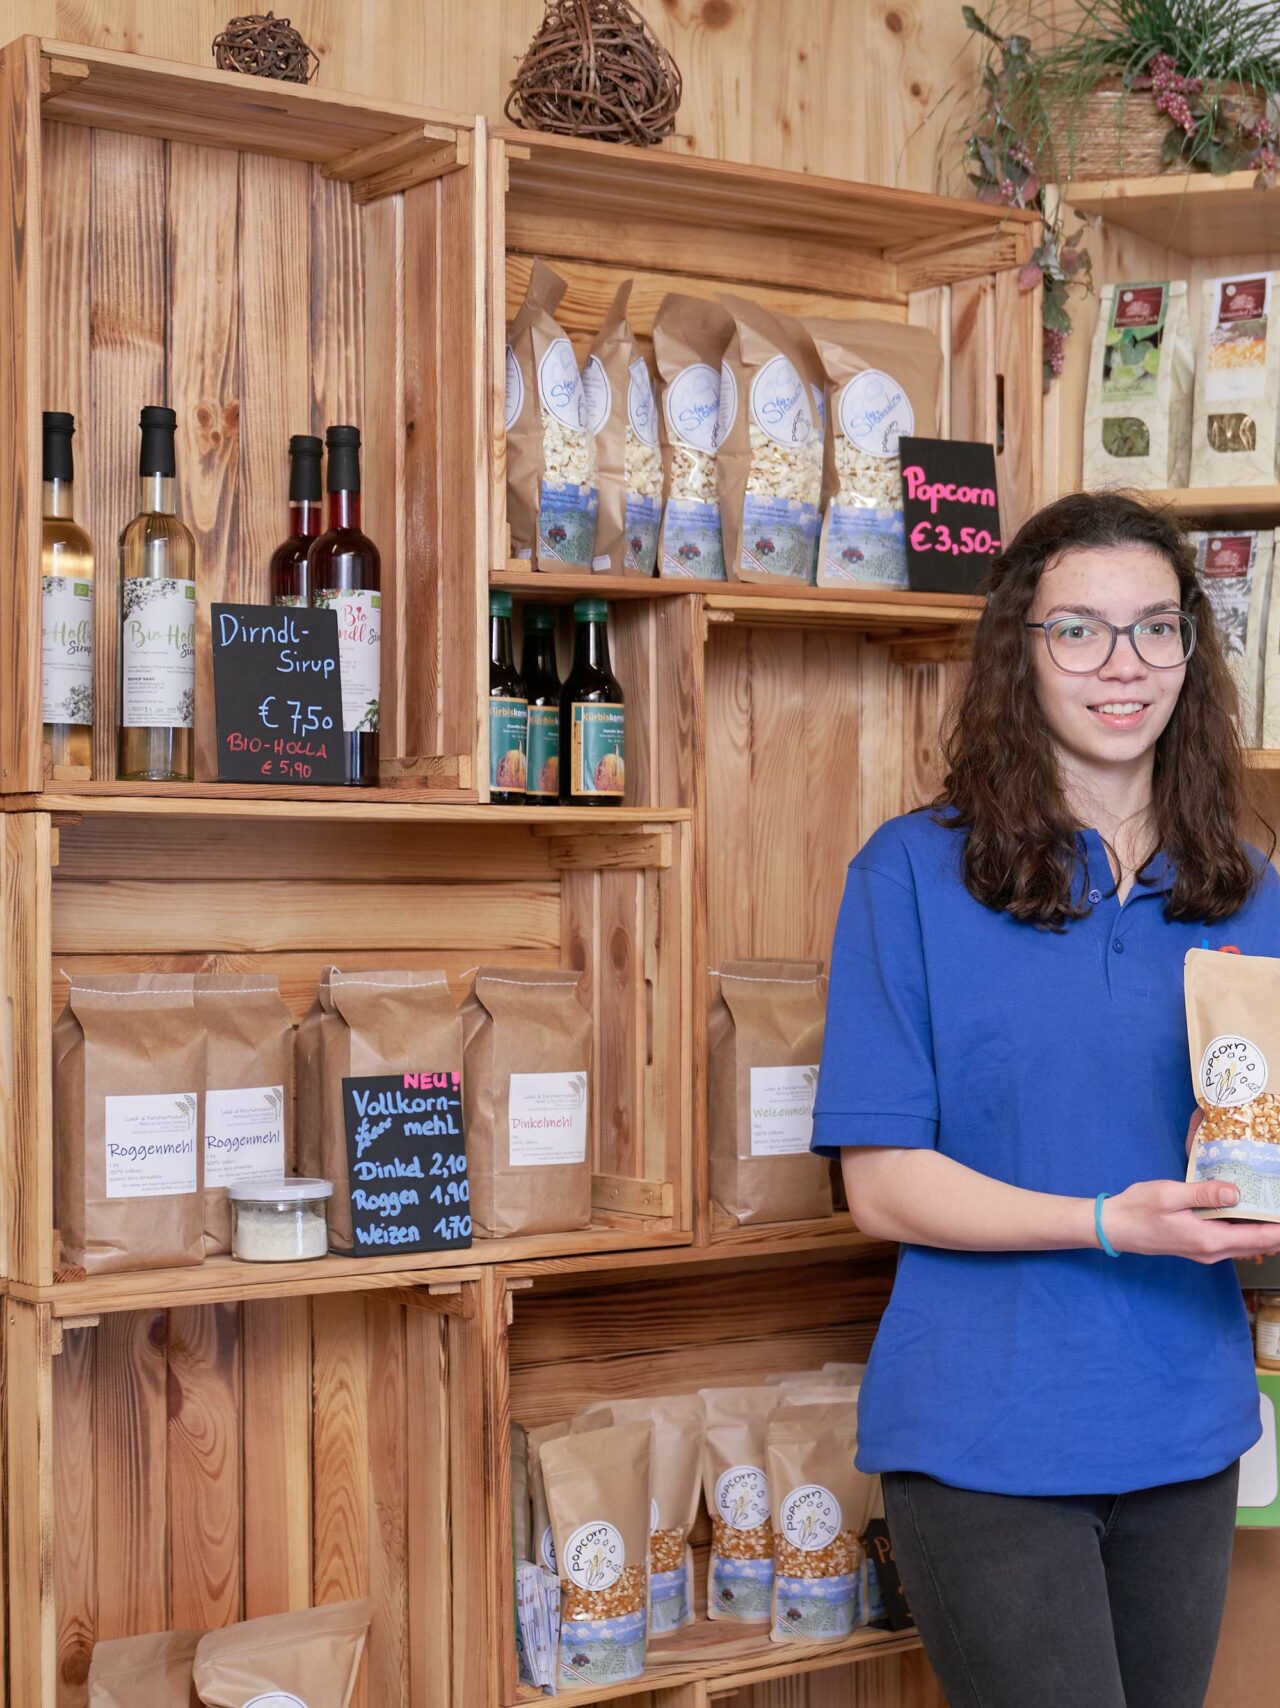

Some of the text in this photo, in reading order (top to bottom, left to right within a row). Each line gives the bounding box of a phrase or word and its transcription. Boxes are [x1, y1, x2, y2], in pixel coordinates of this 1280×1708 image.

[902, 465, 996, 514] Popcorn
[344, 603, 368, 627] Bio
[129, 620, 163, 648] Bio
[219, 613, 309, 647] Dirndl-
[276, 650, 336, 680] Sirup
[258, 696, 334, 737] € 7,50
[226, 732, 328, 759] BIO-HOLLA
[261, 760, 312, 777] € 5,90
[352, 1089, 461, 1118] Vollkorn-
[403, 1114, 460, 1137] mehl
[511, 1116, 573, 1130] Dinkelmehl
[107, 1139, 194, 1162] Roggenmehl
[204, 1130, 281, 1153] Roggenmehl
[353, 1152, 467, 1181] Dinkel 2,10
[351, 1180, 470, 1217] Roggen 1,90
[356, 1215, 473, 1245] Weizen 1,70
